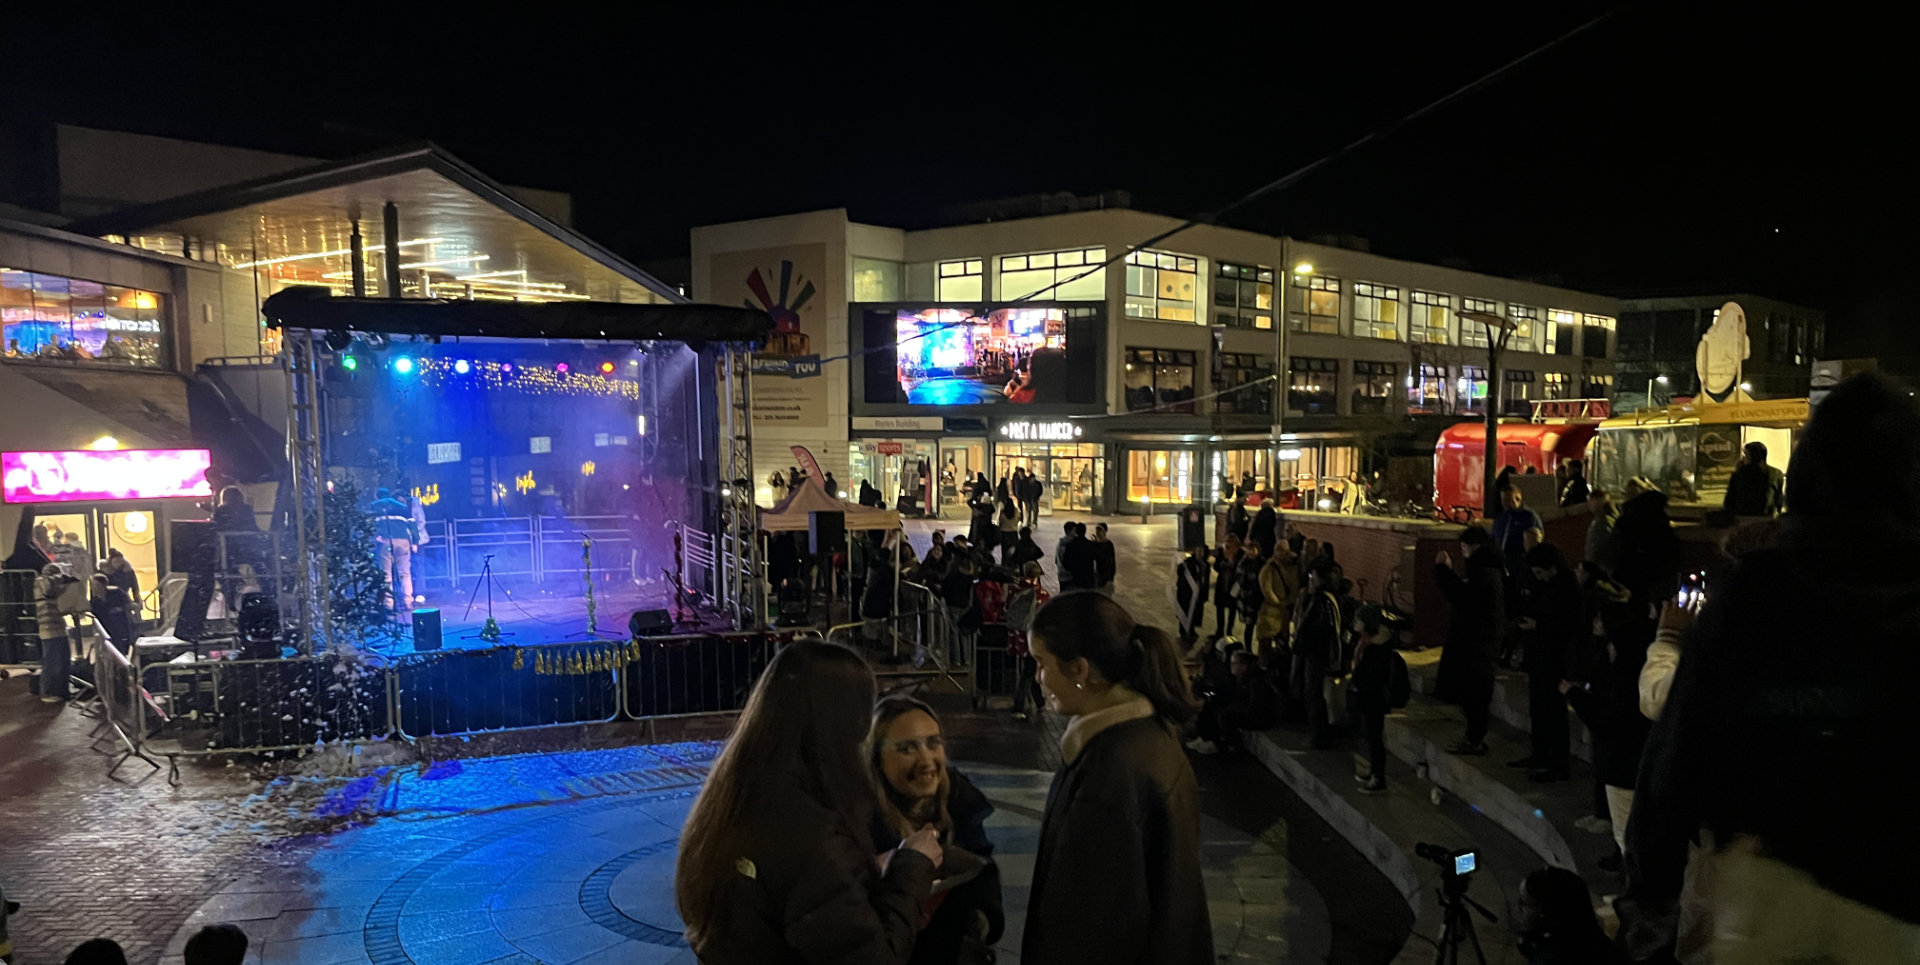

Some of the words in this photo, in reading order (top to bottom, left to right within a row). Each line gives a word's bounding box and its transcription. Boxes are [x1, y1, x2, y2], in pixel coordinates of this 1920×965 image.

[795, 363, 816, 375] YOU
[896, 419, 921, 428] Building
[1009, 422, 1030, 440] PRET
[1031, 423, 1037, 440] A
[1038, 422, 1073, 440] MANGER
[879, 443, 902, 453] sports
